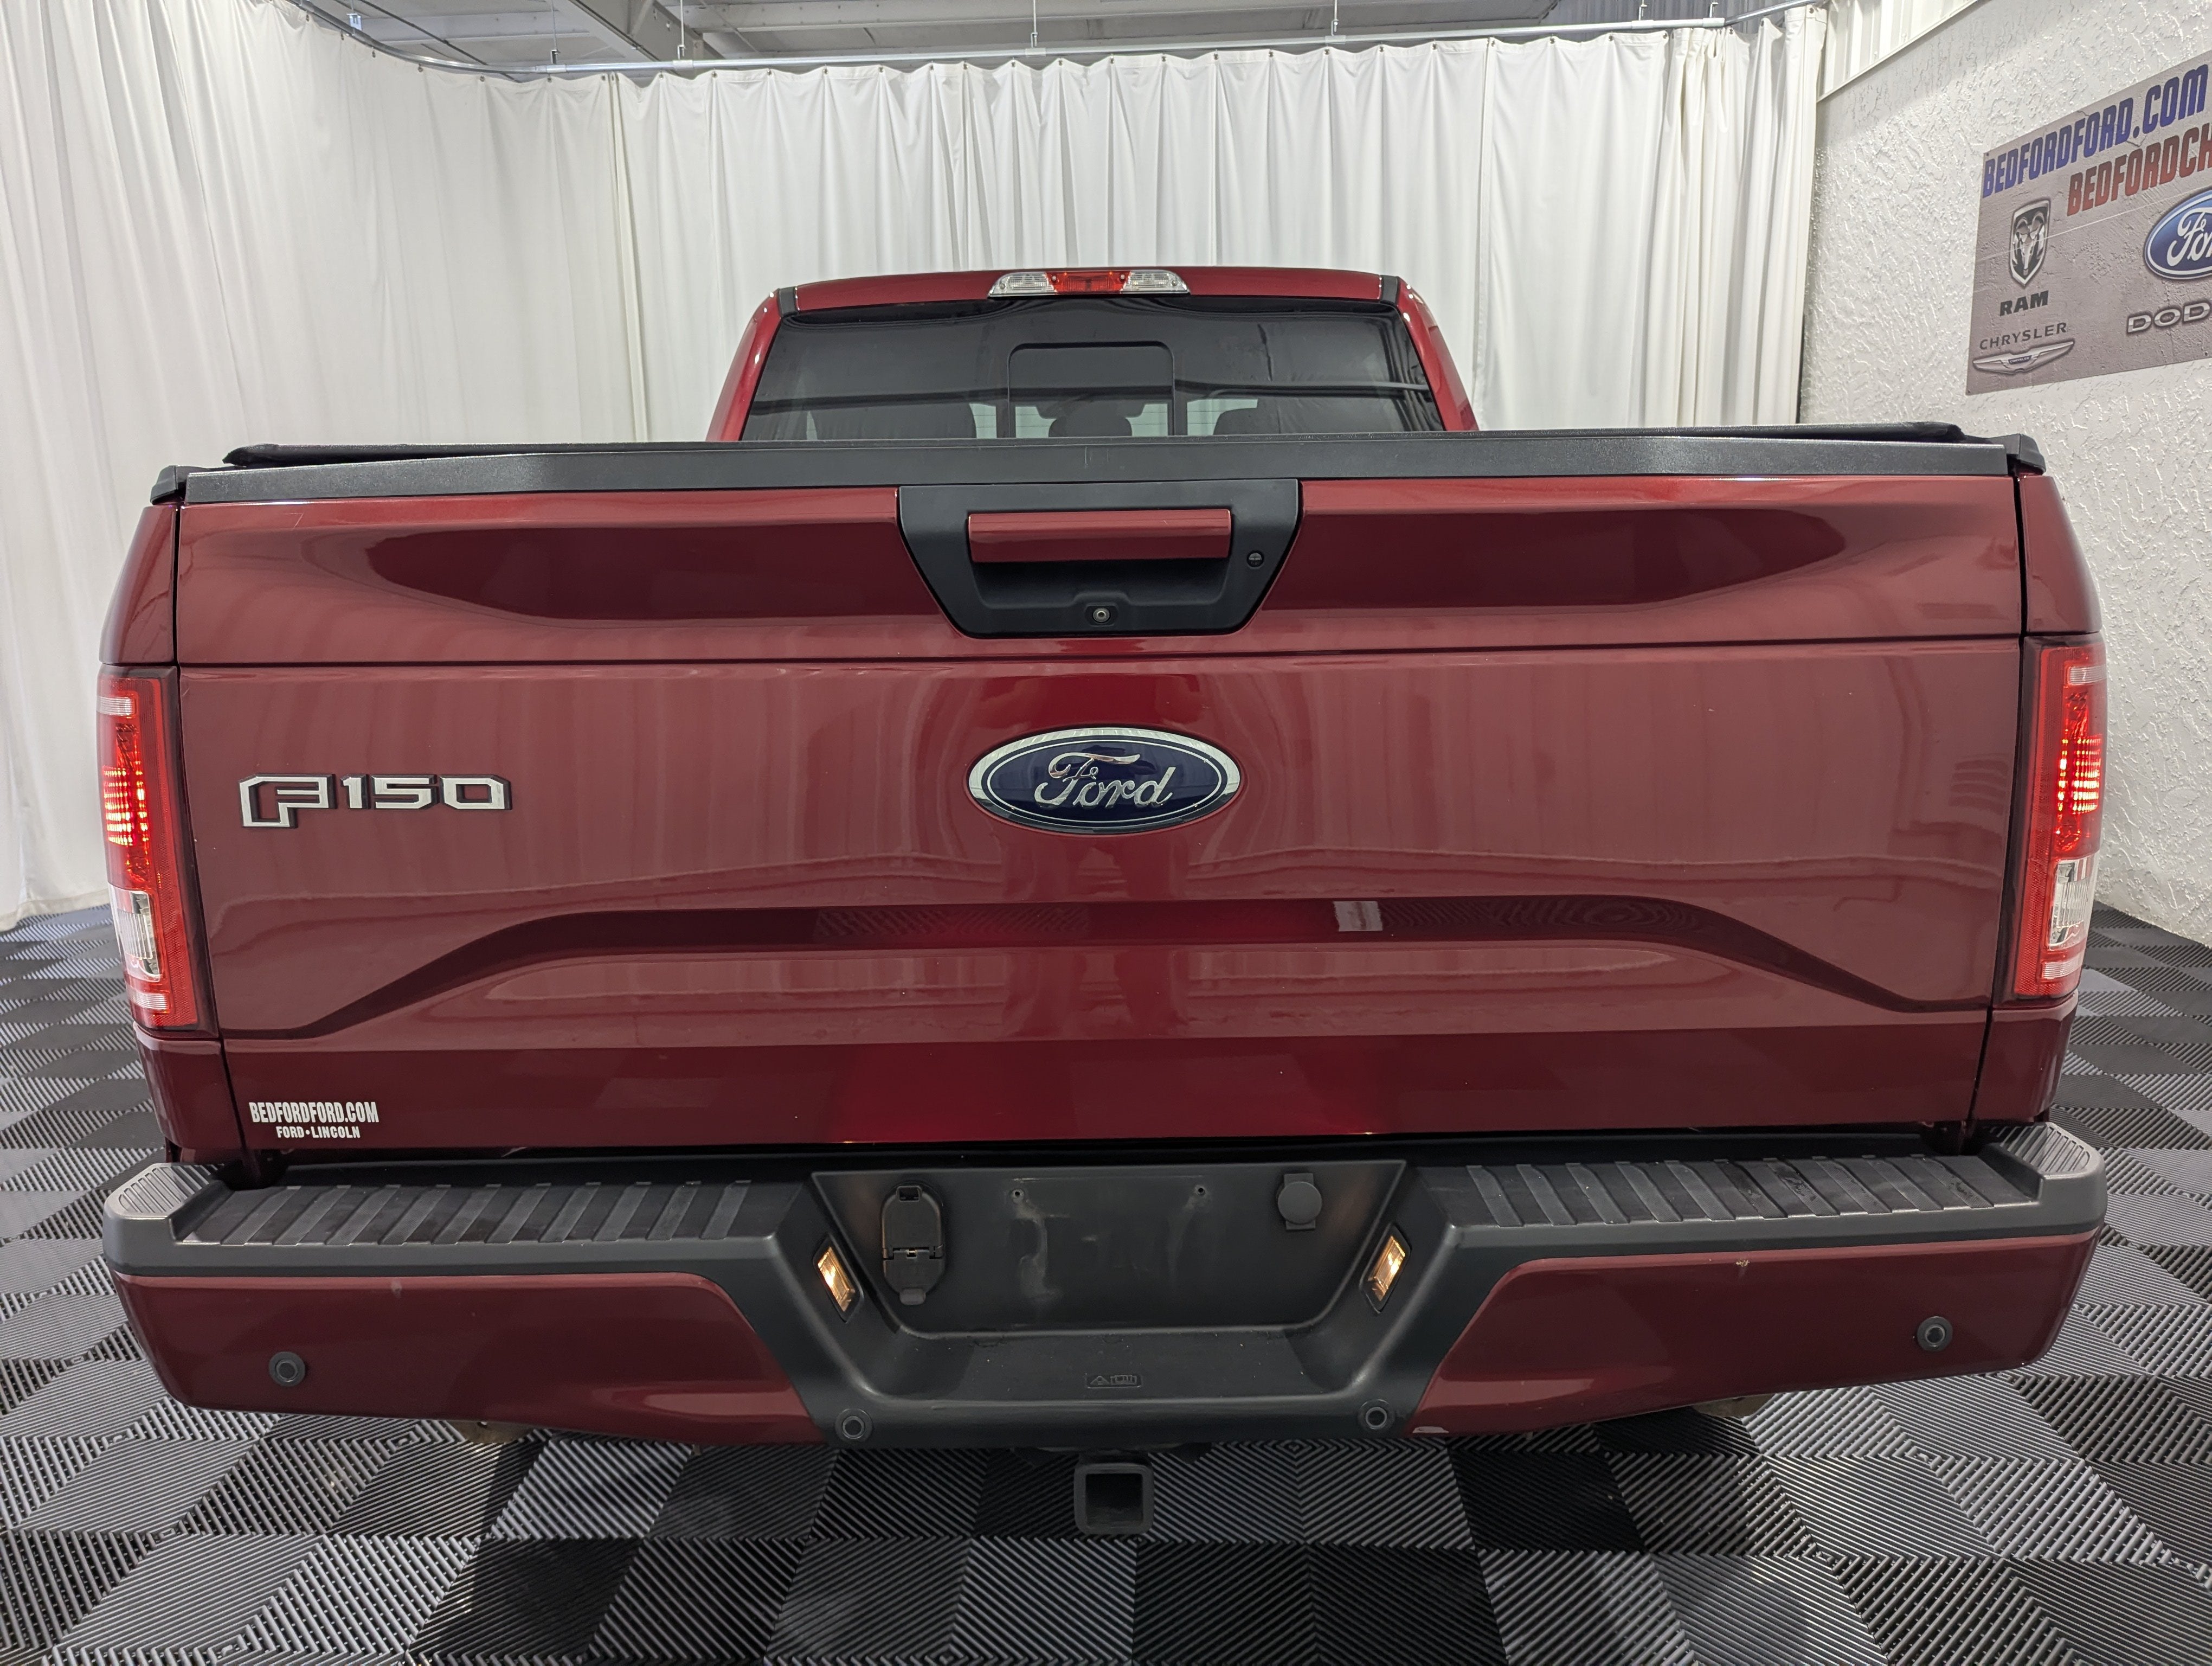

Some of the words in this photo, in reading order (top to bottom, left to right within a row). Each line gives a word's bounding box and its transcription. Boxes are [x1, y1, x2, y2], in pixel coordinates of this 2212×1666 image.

[1982, 64, 2209, 198] BEDFORDFORD.COM
[1999, 290, 2049, 317] RAM
[1980, 322, 2067, 350] CHRYSLER
[1034, 752, 1176, 808] Ford
[248, 1101, 380, 1123] BEDFORDFORD.COM
